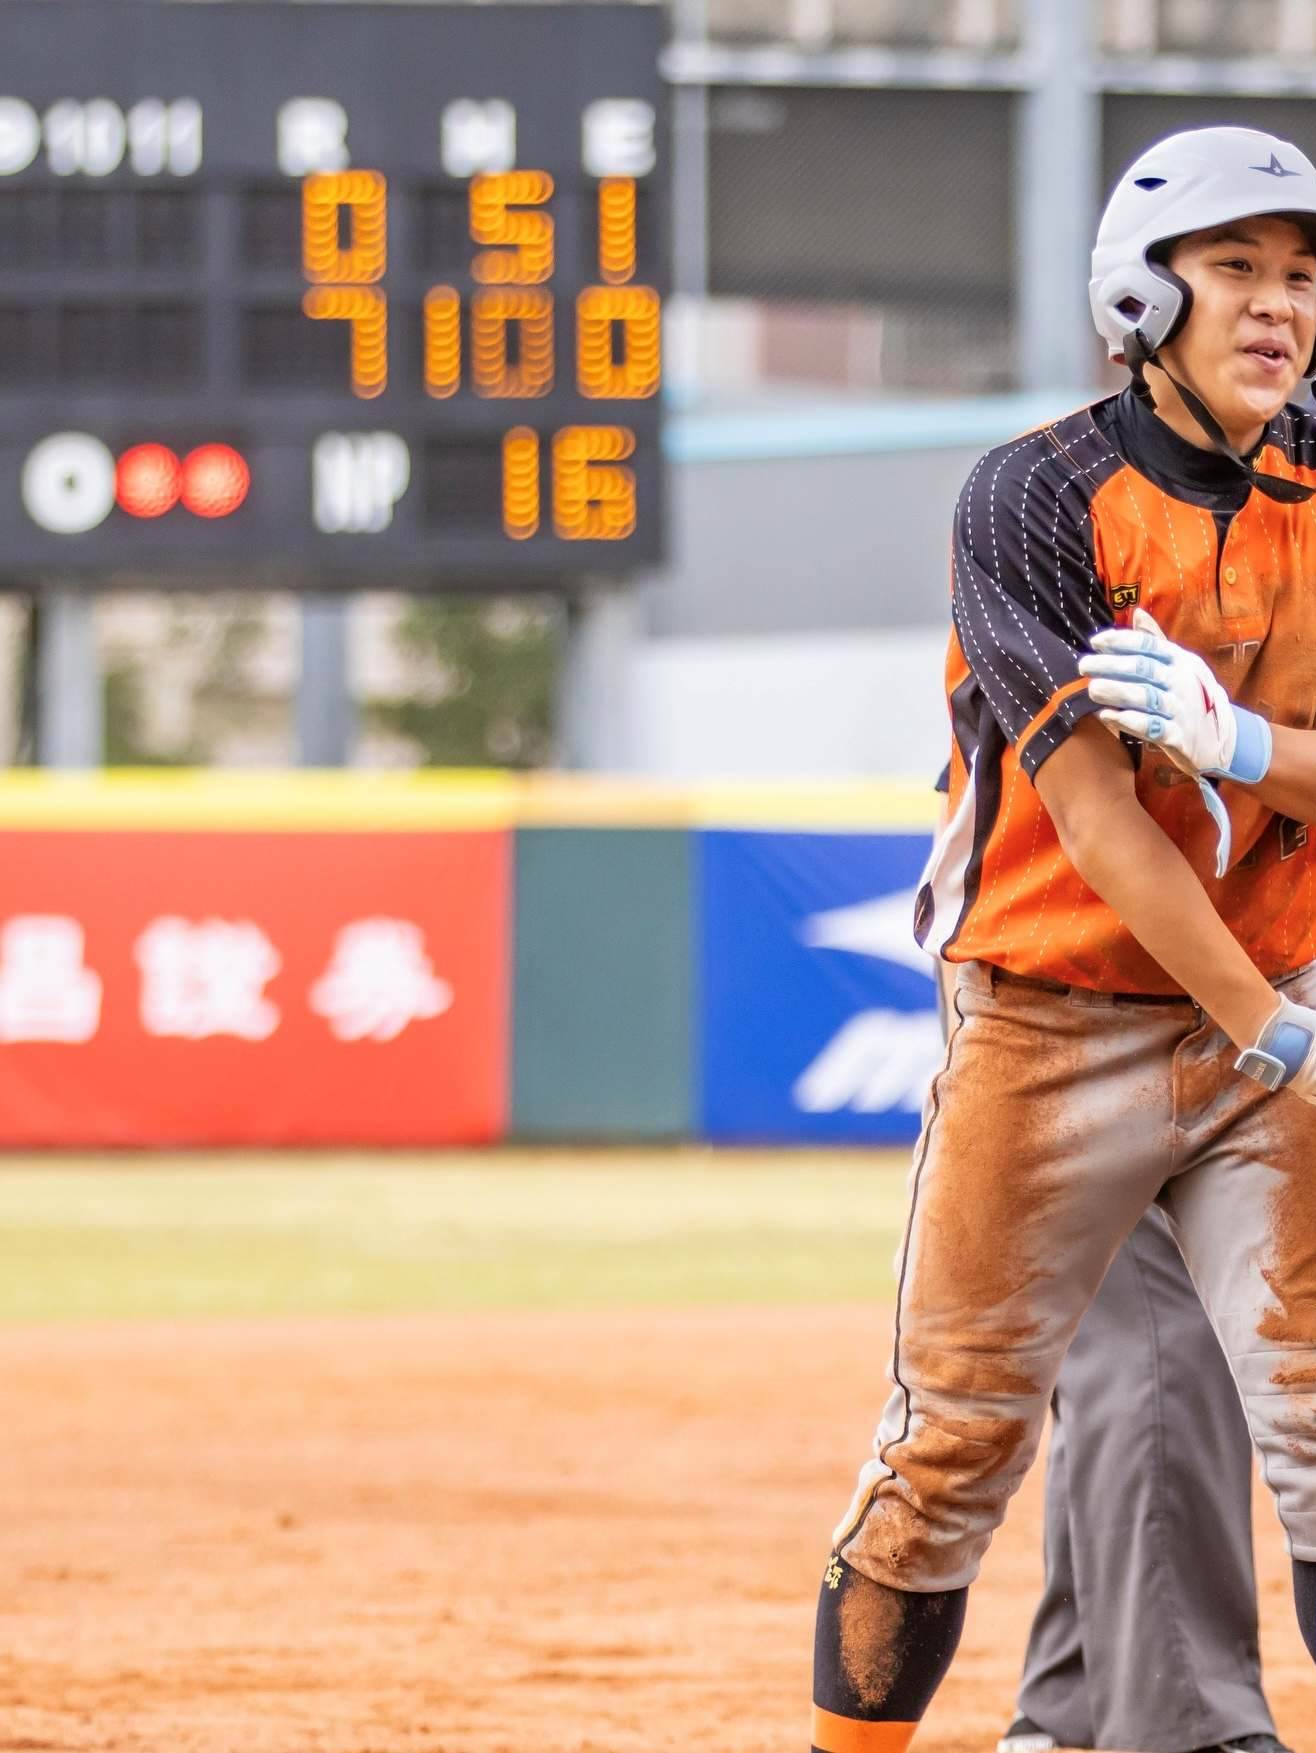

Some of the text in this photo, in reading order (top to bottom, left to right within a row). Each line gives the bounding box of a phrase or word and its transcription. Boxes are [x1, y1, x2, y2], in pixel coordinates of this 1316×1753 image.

[582, 98, 656, 178] E
[303, 169, 636, 284] 0 5 1
[303, 285, 661, 399] 7 10 0
[503, 426, 636, 540] 16
